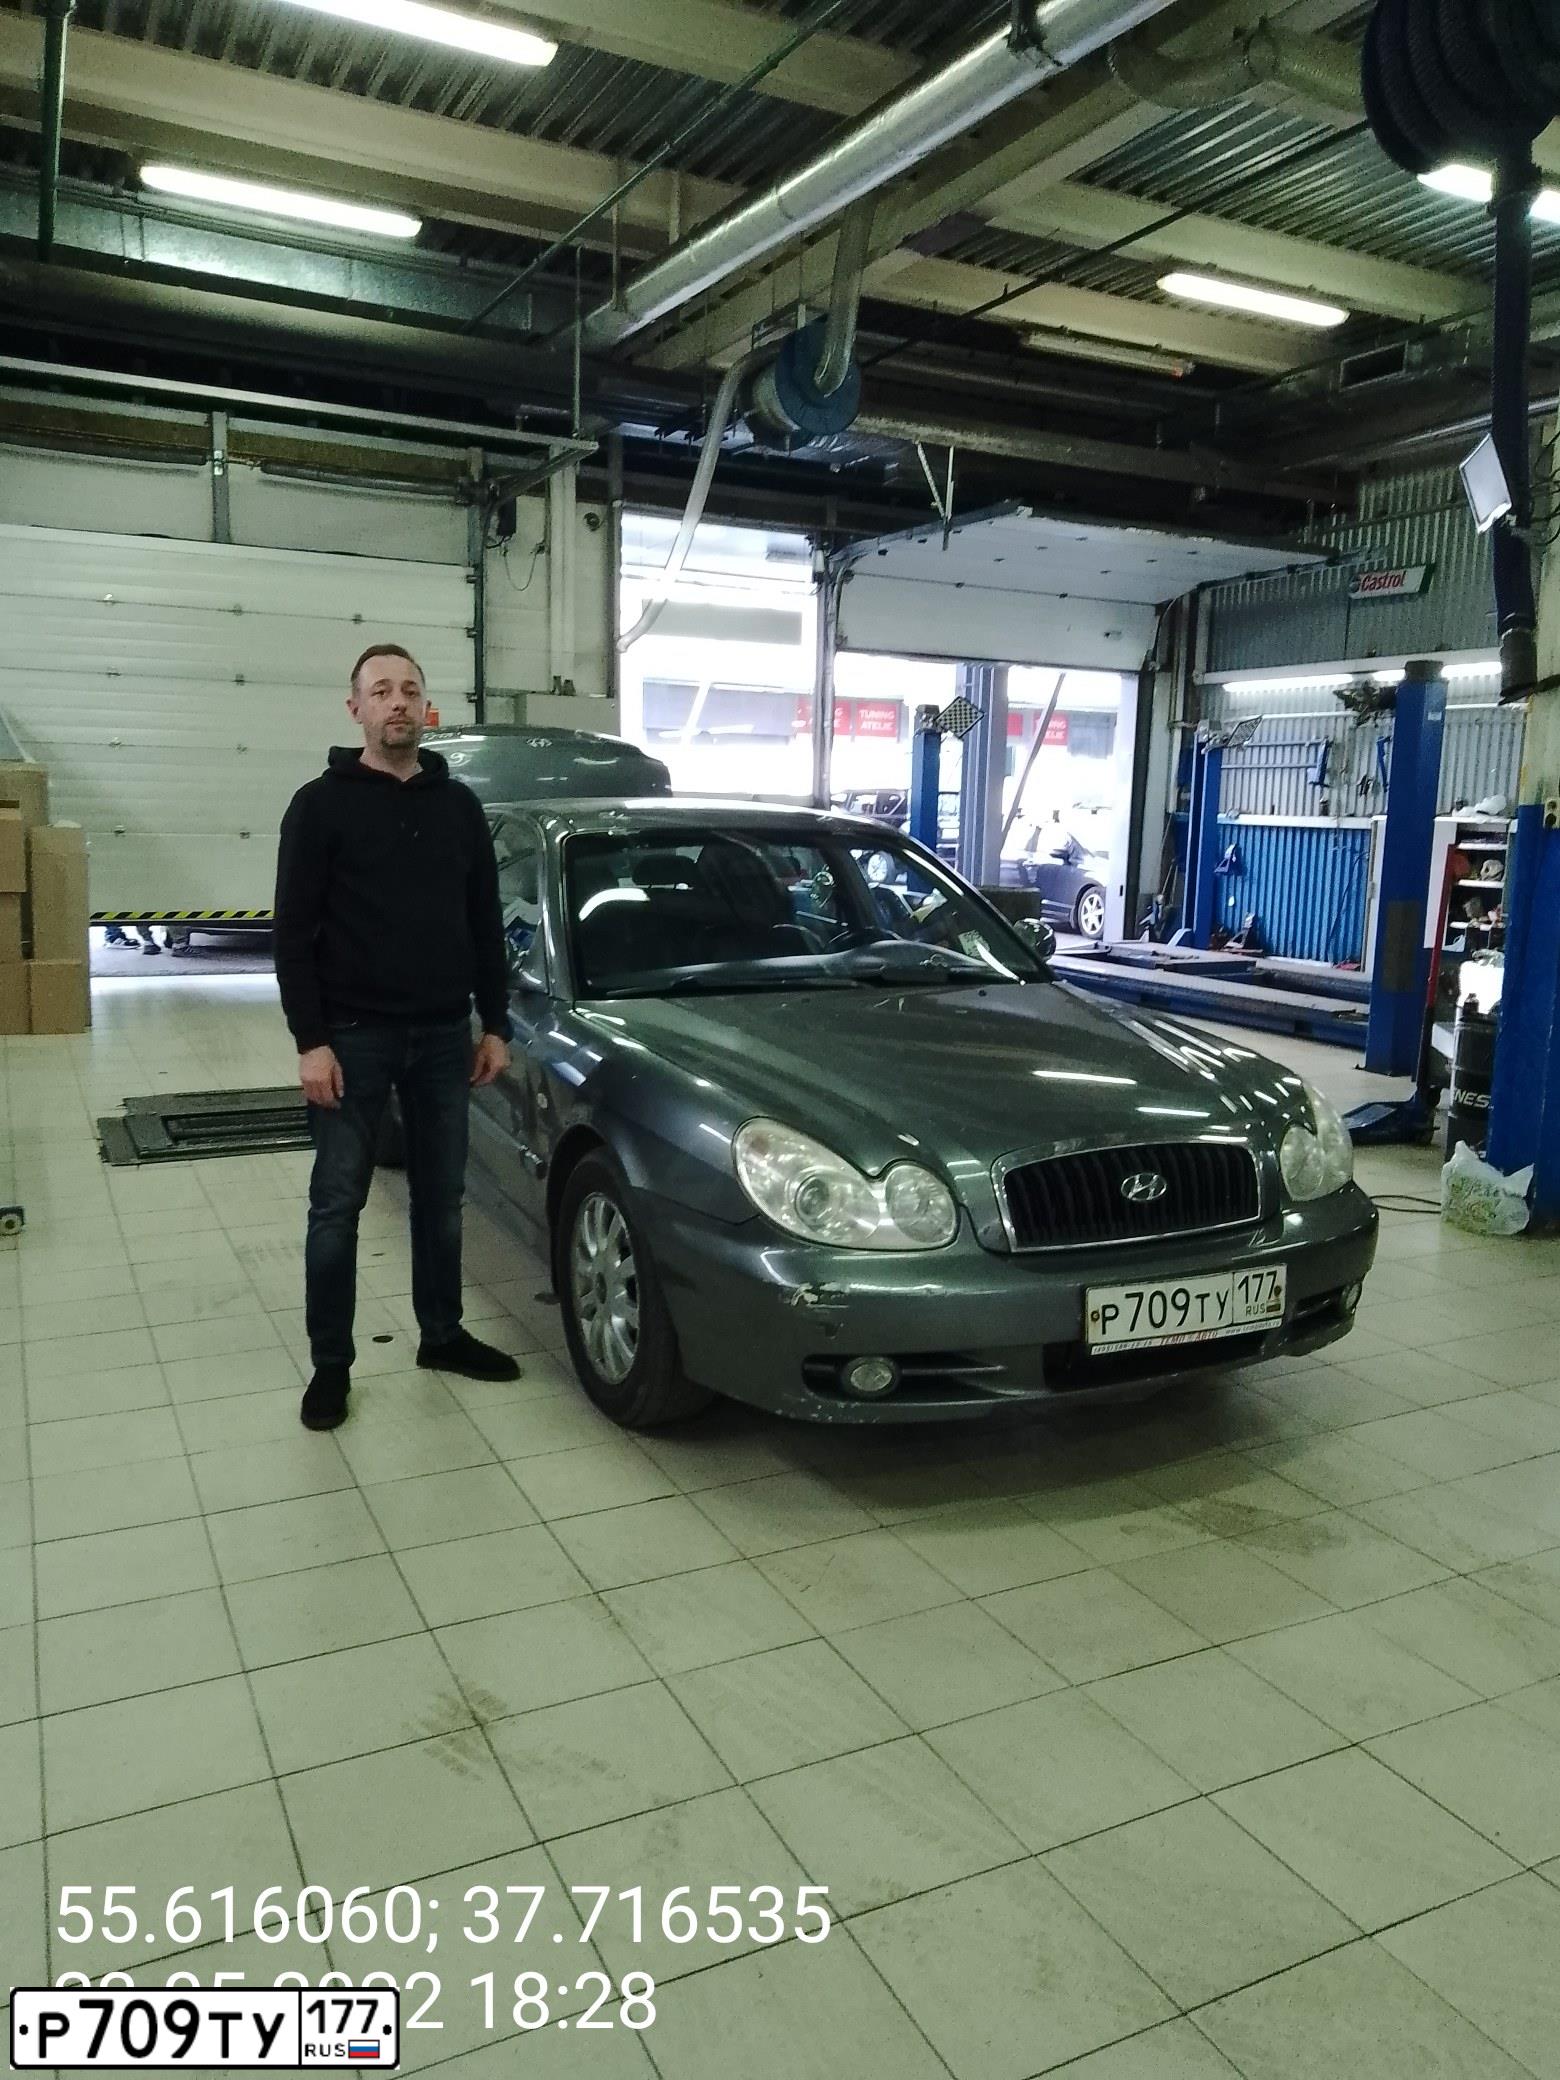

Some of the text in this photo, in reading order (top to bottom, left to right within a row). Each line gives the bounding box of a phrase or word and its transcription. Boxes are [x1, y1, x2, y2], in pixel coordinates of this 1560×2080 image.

[1361, 570, 1407, 591] Castrol
[860, 709, 895, 720] TUNING
[1237, 1271, 1278, 1304] 177
[1245, 1304, 1266, 1316] RUS
